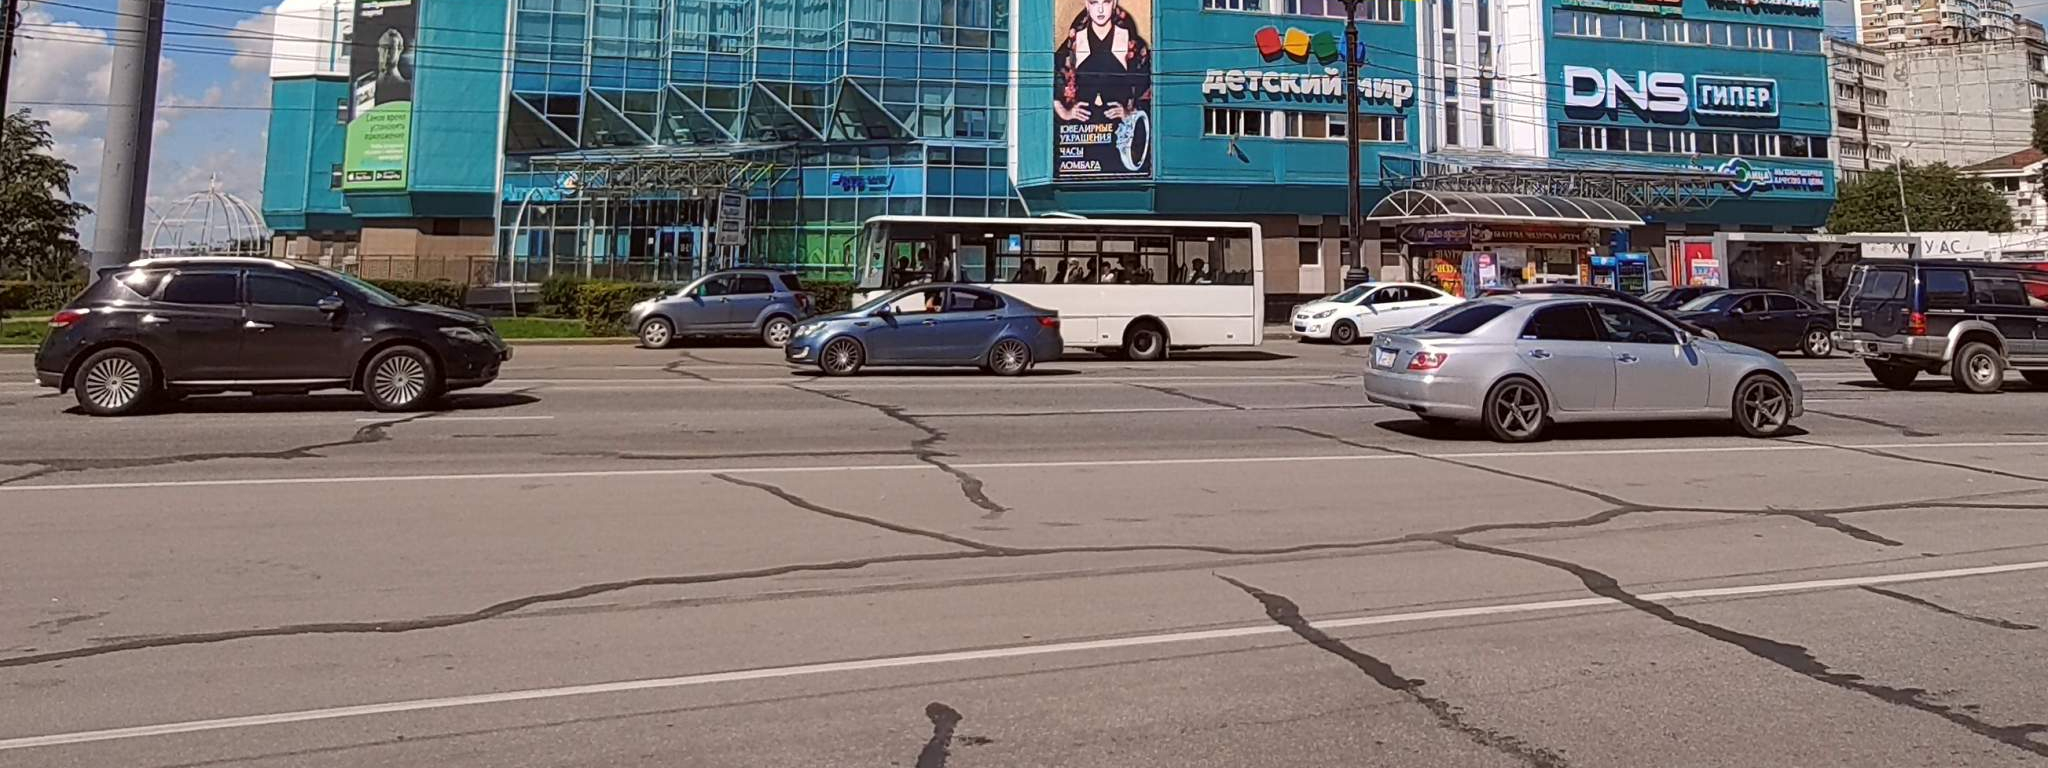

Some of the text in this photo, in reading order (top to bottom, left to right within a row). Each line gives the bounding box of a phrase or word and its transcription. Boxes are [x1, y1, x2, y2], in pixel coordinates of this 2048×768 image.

[1202, 67, 1413, 107] детский мир
[1563, 64, 1688, 112] DNS
[1702, 85, 1770, 107] ГИПЕР
[1060, 123, 1113, 133] ЮВЕЛИРНЫЕ
[1060, 133, 1112, 142] УКРАШЕНИЯ
[1060, 147, 1084, 155] ЧАСЫ
[1060, 160, 1101, 170] ЛОМБАРД
